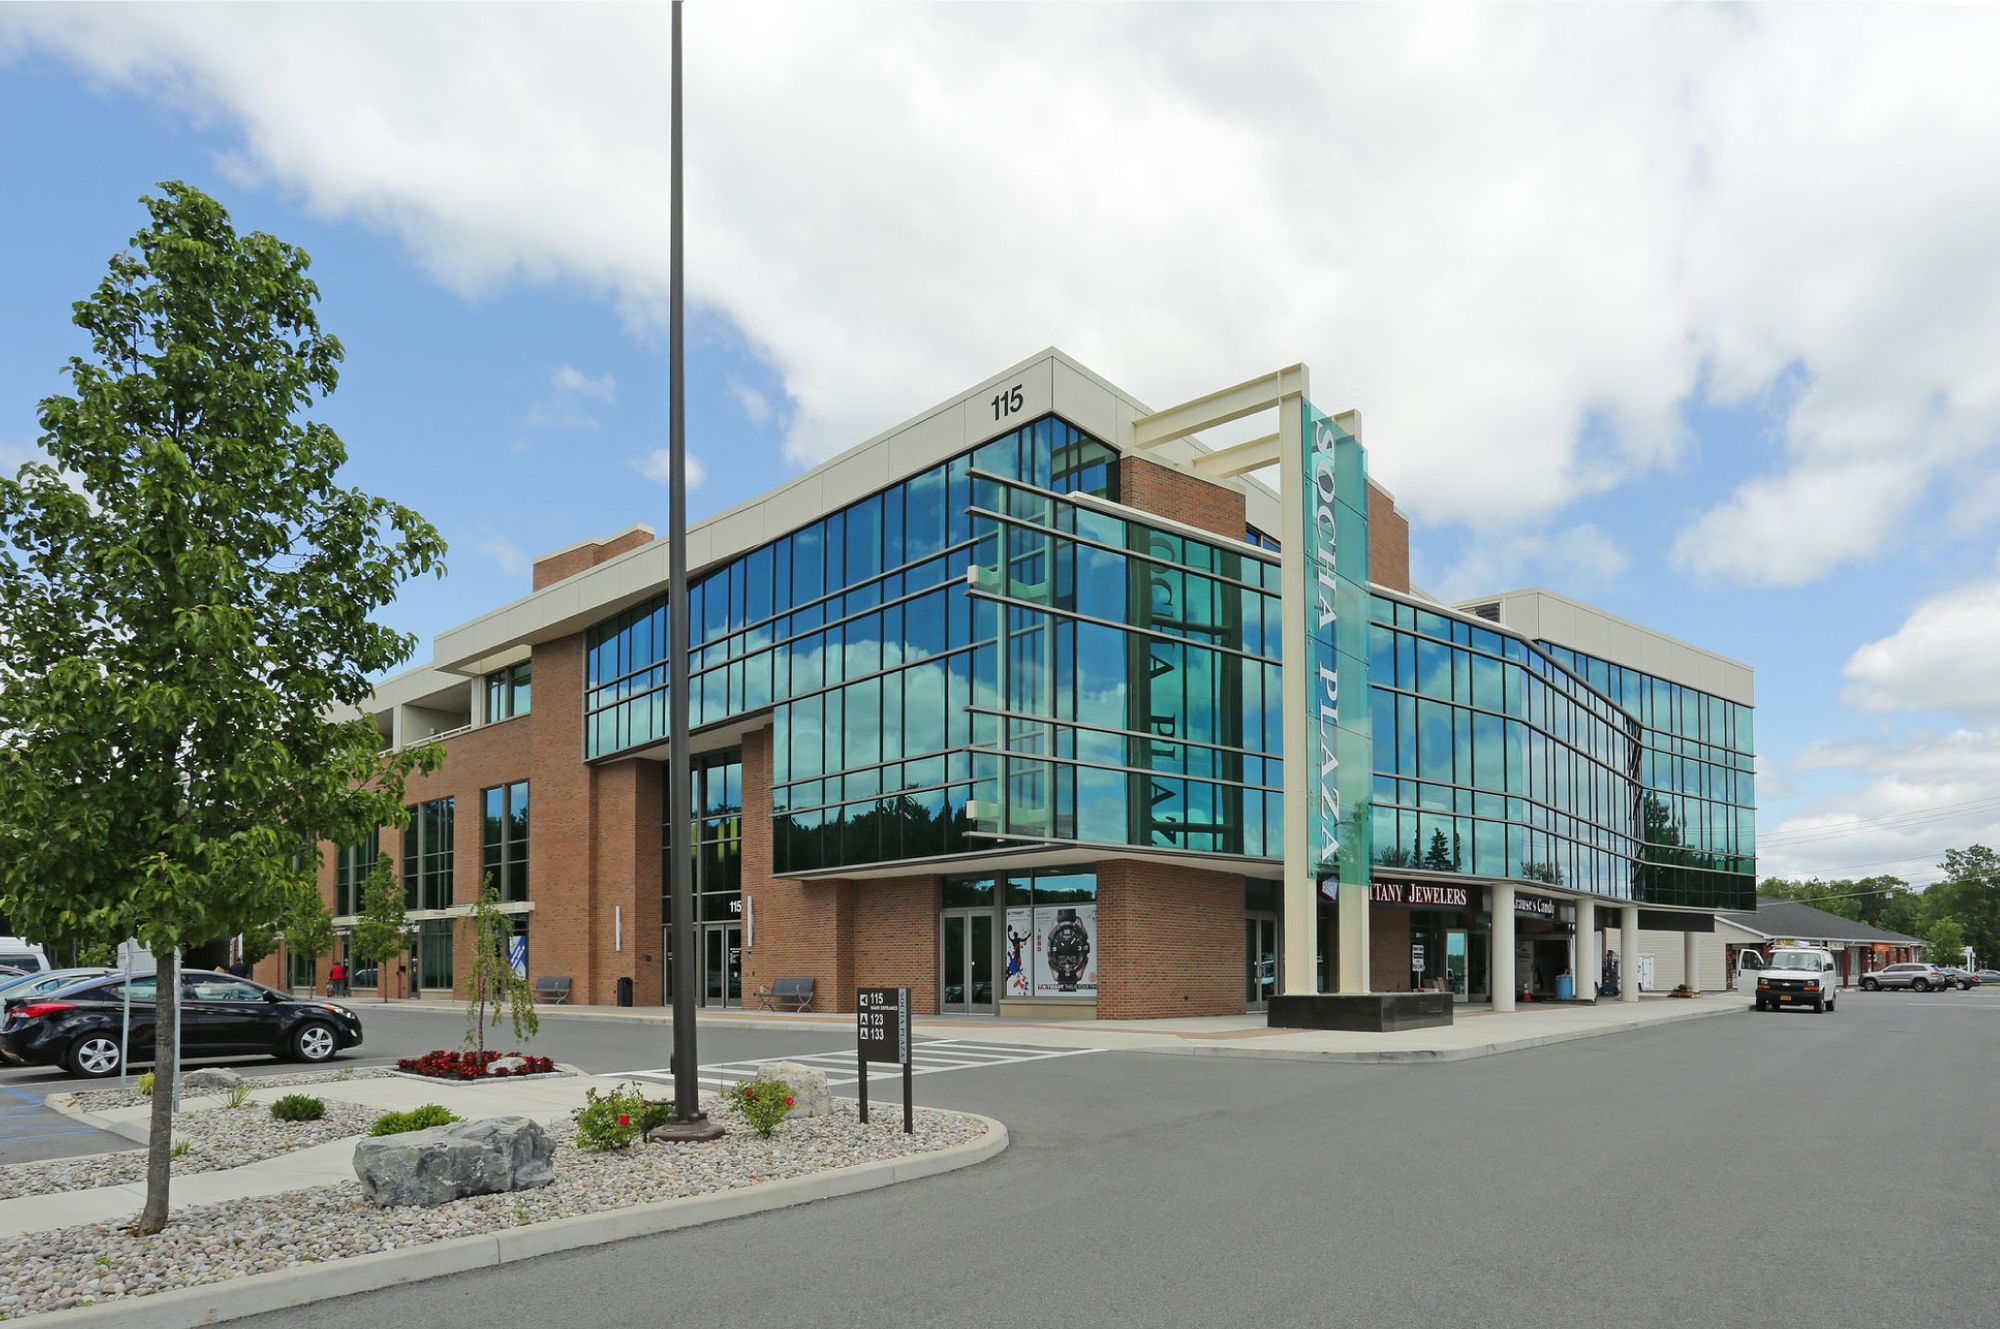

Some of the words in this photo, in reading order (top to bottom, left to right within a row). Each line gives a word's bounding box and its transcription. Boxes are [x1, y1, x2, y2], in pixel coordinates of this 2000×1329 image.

[991, 384, 1023, 421] 115
[1315, 420, 1337, 630] SOCHA
[1319, 661, 1340, 864] PLAZA
[1408, 883, 1467, 905] JEWELERS
[729, 900, 742, 913] 115
[870, 992, 884, 1004] 115
[870, 1013, 884, 1025] 123
[870, 1028, 885, 1040] 133
